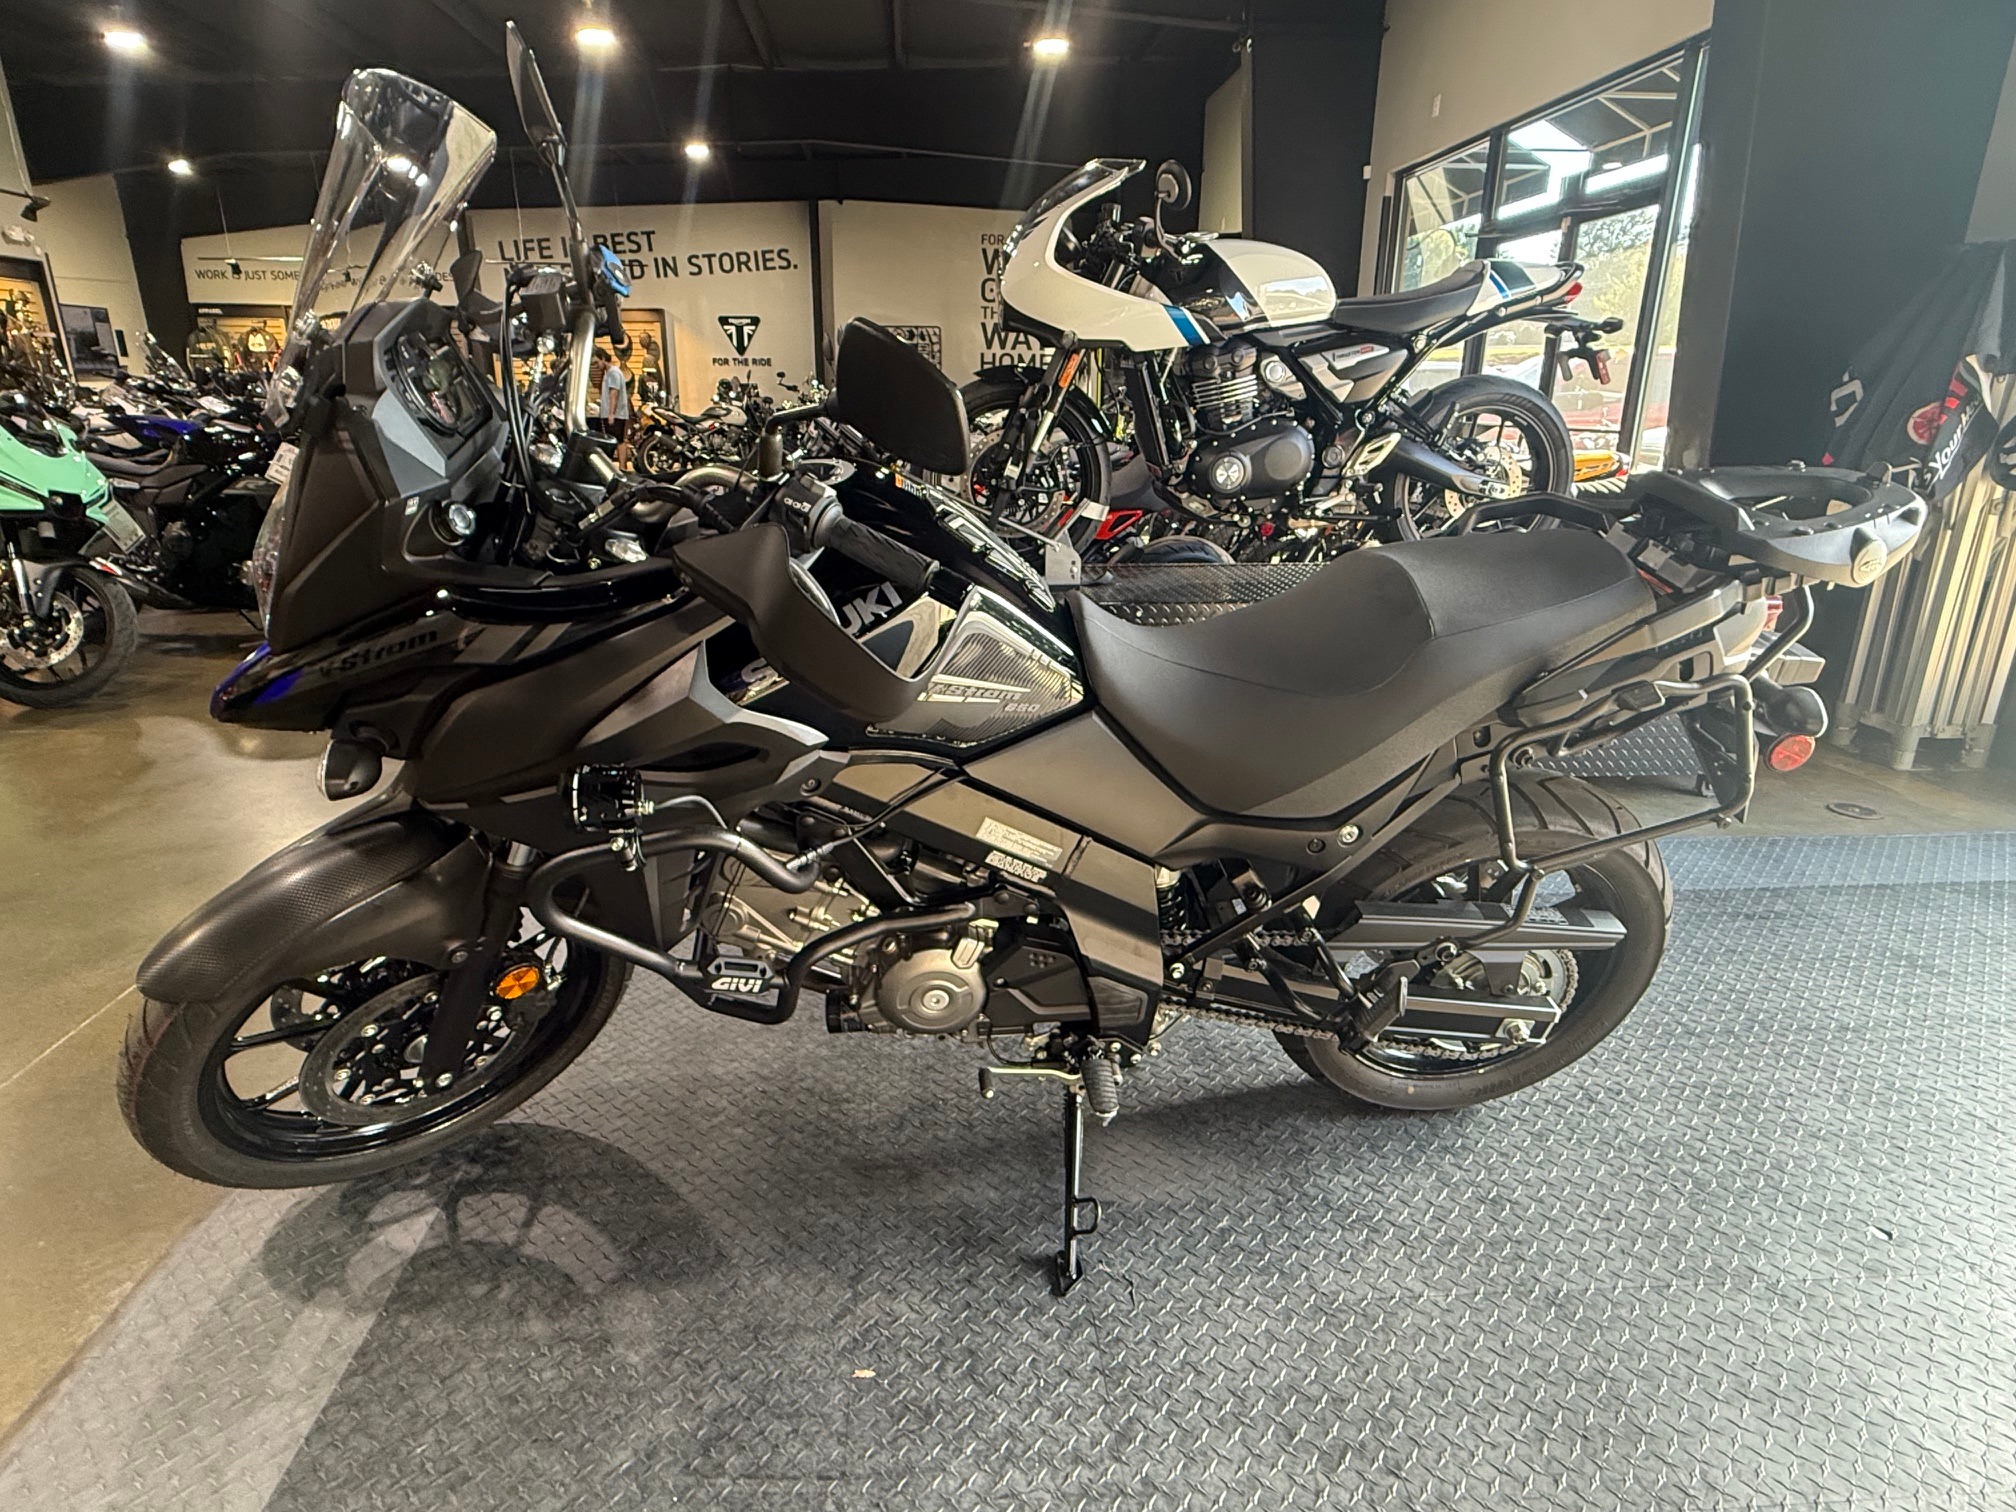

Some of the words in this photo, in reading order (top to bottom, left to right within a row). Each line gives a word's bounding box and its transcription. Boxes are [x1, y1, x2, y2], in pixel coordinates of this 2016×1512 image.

[498, 237, 553, 262] LIFE
[593, 230, 656, 254] BEST
[981, 234, 1005, 246] FOR
[654, 256, 679, 279] IN
[688, 248, 798, 276] STORIES.
[195, 269, 228, 280] WORK
[244, 270, 268, 281] JUST
[270, 270, 300, 280] SOME
[712, 357, 730, 367] FOR
[732, 357, 749, 367] THE
[752, 357, 772, 367] RIDE
[711, 977, 763, 992] GIVI
